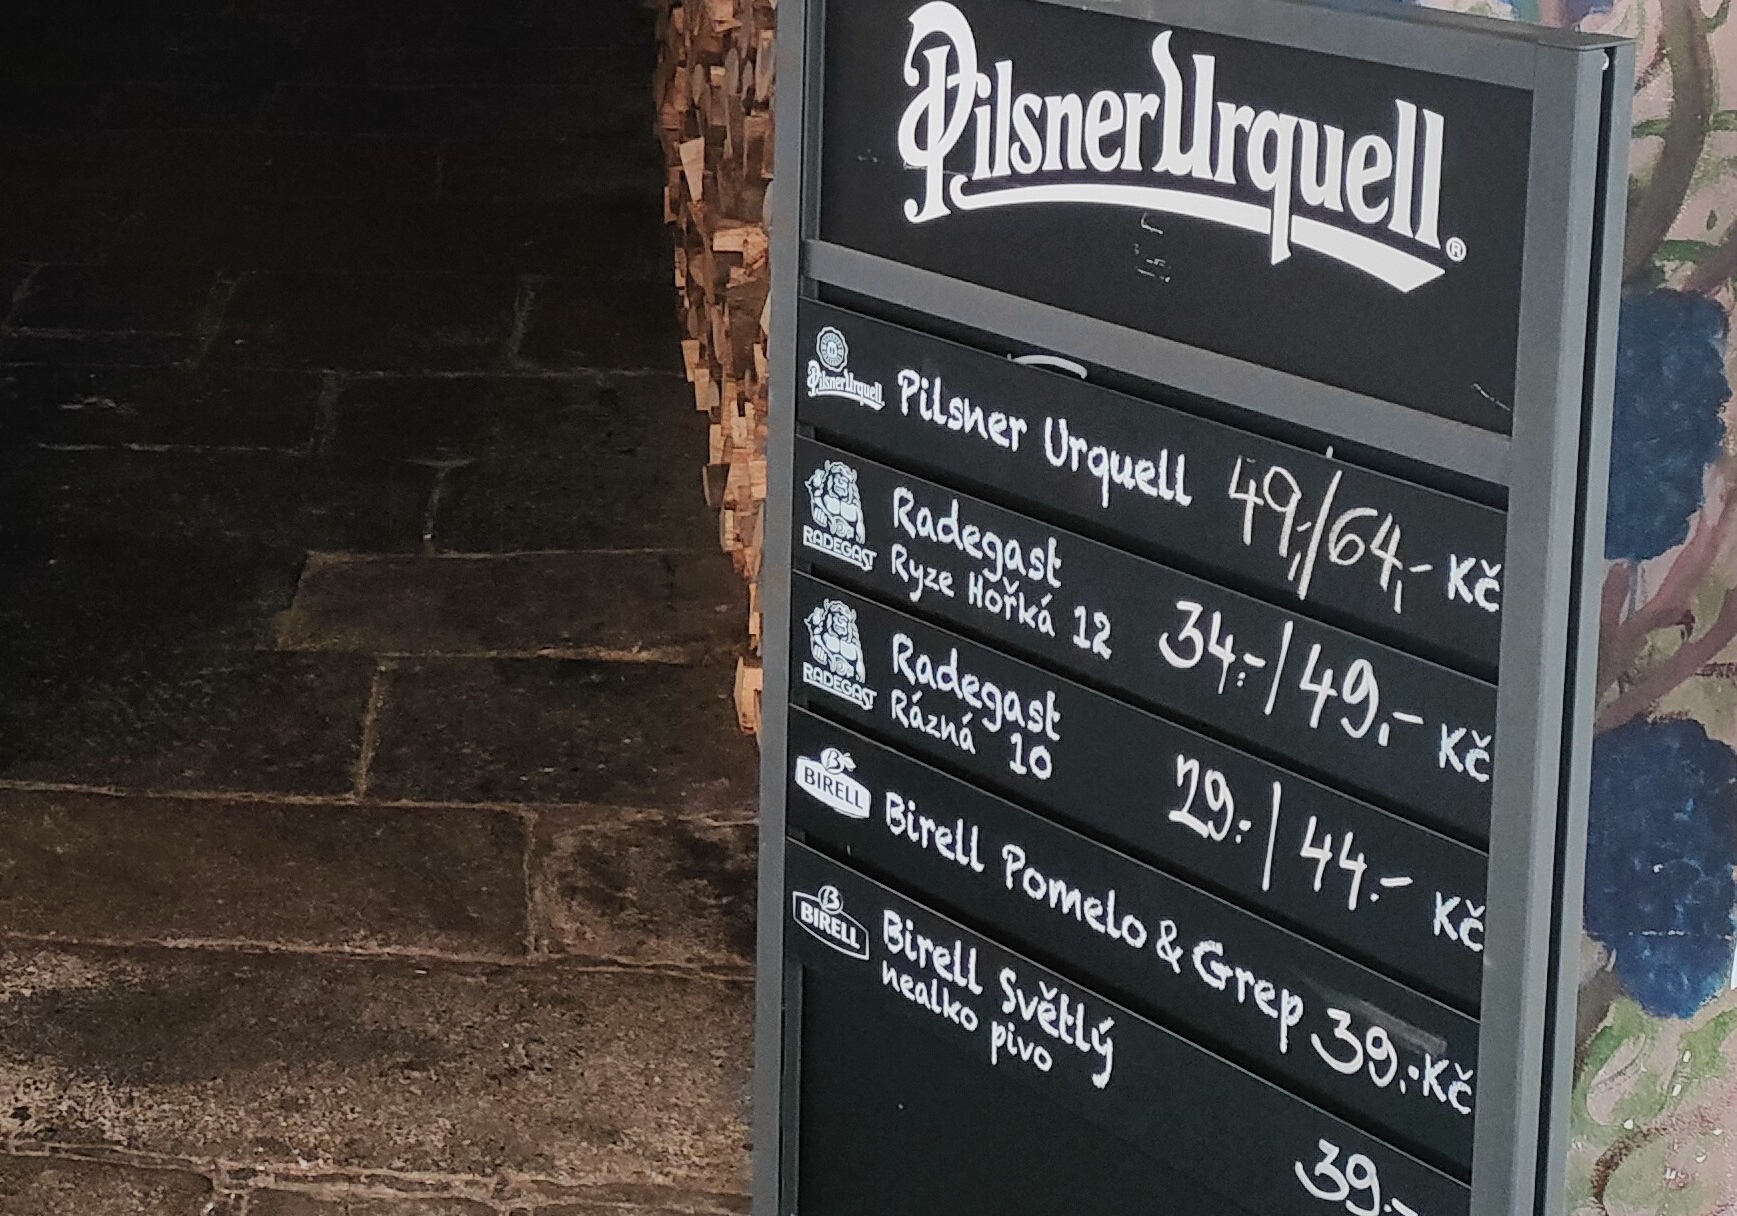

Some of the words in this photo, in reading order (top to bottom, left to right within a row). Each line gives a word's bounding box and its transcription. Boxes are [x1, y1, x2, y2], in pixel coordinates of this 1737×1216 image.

[898, 1, 1161, 224] Pilsner
[1151, 29, 1445, 266] Urquell
[807, 359, 846, 397] Pilsner
[844, 368, 883, 406] Urquell
[897, 368, 1027, 452] Pilsner
[1044, 417, 1192, 508] Urquell
[803, 525, 877, 570] RADEGAST
[892, 486, 1062, 588] Radegast
[1448, 553, 1502, 612] Kč
[891, 543, 954, 602] Ryze
[968, 571, 1055, 637] Hořká
[1072, 605, 1112, 660] 12
[803, 662, 877, 707] RADEGAST
[892, 633, 1061, 741] Radegast
[890, 688, 976, 755] Rázná
[1009, 732, 1053, 780] 10
[1439, 723, 1492, 782] Kč
[804, 766, 864, 810] BIRELL
[800, 900, 861, 950] BIRELL
[885, 791, 985, 873] Birell
[1002, 844, 1148, 948] Pomelo
[1156, 919, 1184, 974] &
[1192, 939, 1304, 1054] Grep
[1433, 891, 1486, 952] Kč
[882, 959, 979, 1032] nealko
[991, 1020, 1053, 1072] pivo
[883, 909, 983, 995] Birell
[999, 967, 1114, 1089] Světlý
